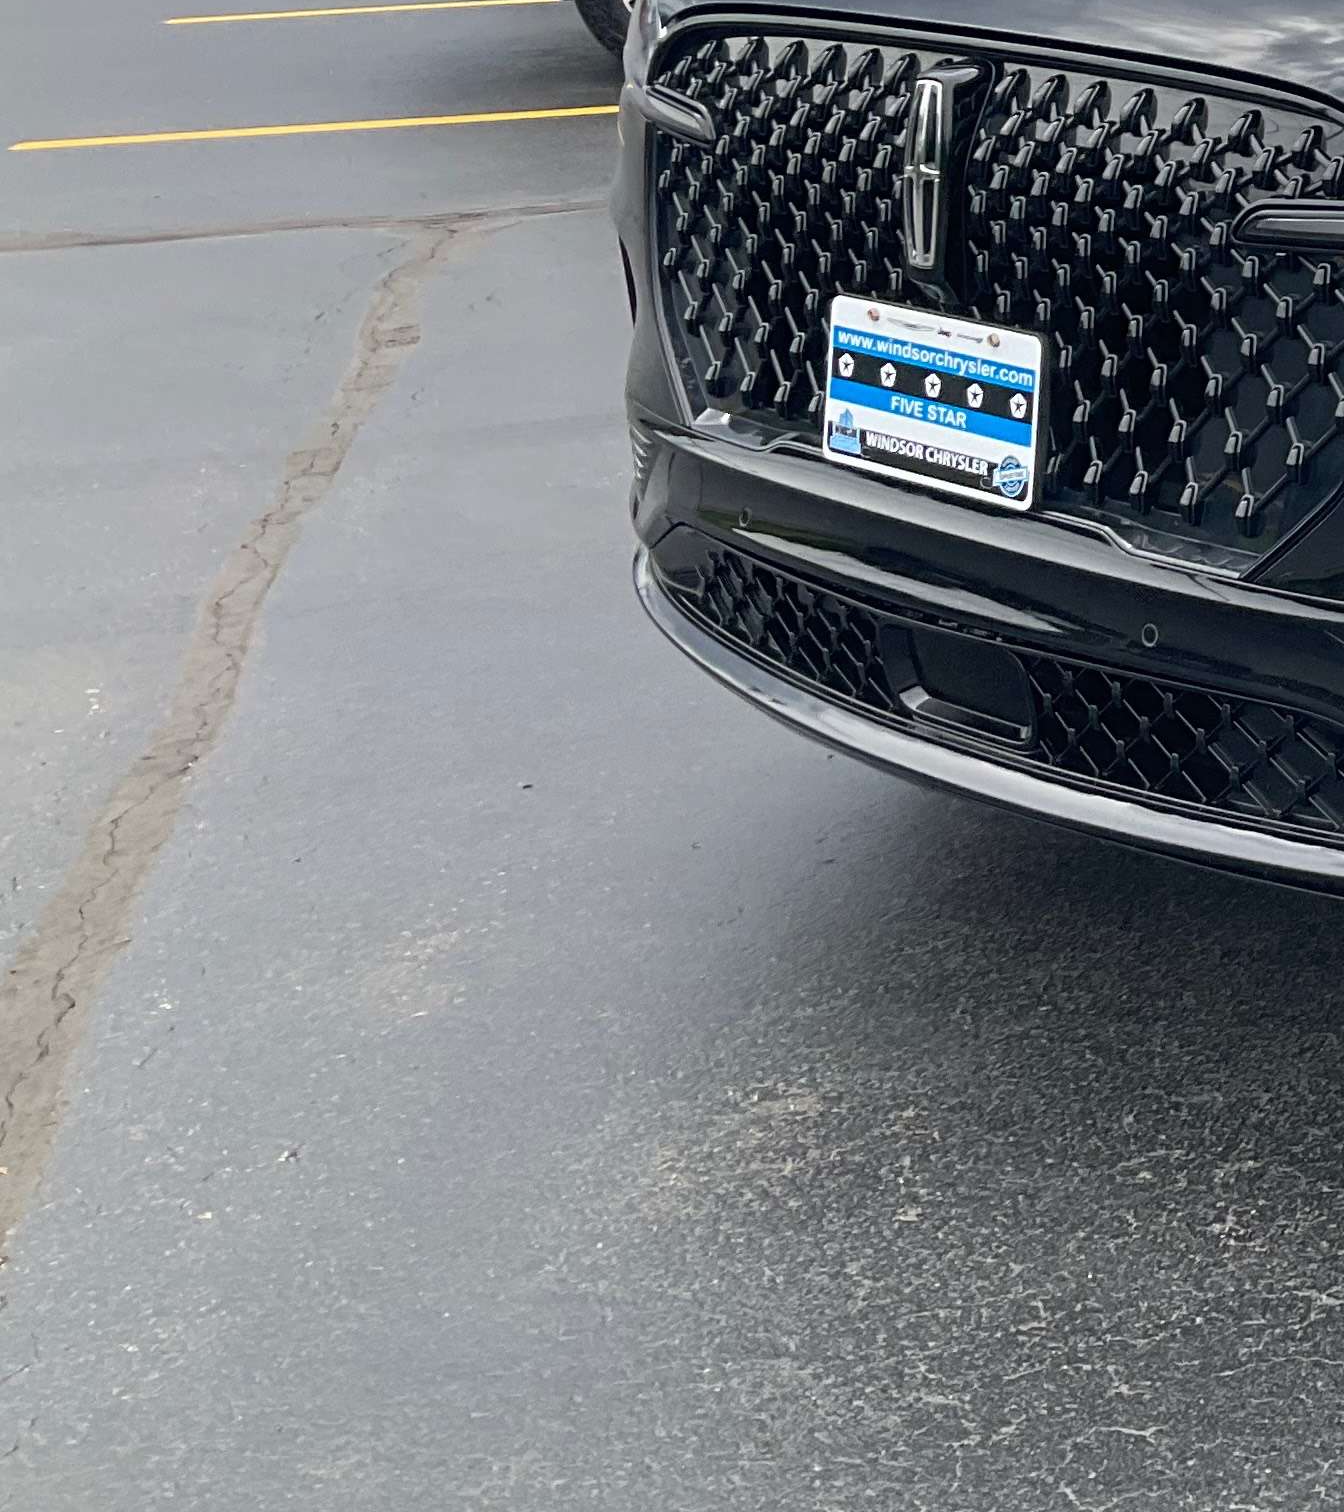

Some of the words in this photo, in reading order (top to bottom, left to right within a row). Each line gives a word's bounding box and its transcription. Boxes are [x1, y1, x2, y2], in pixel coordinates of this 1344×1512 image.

[838, 330, 1033, 387] www.windsorchrysler.com
[890, 396, 924, 417] FIVE
[927, 404, 968, 429] STAR
[865, 431, 923, 461] WINDSOR
[925, 446, 989, 477] CHRYSLER
